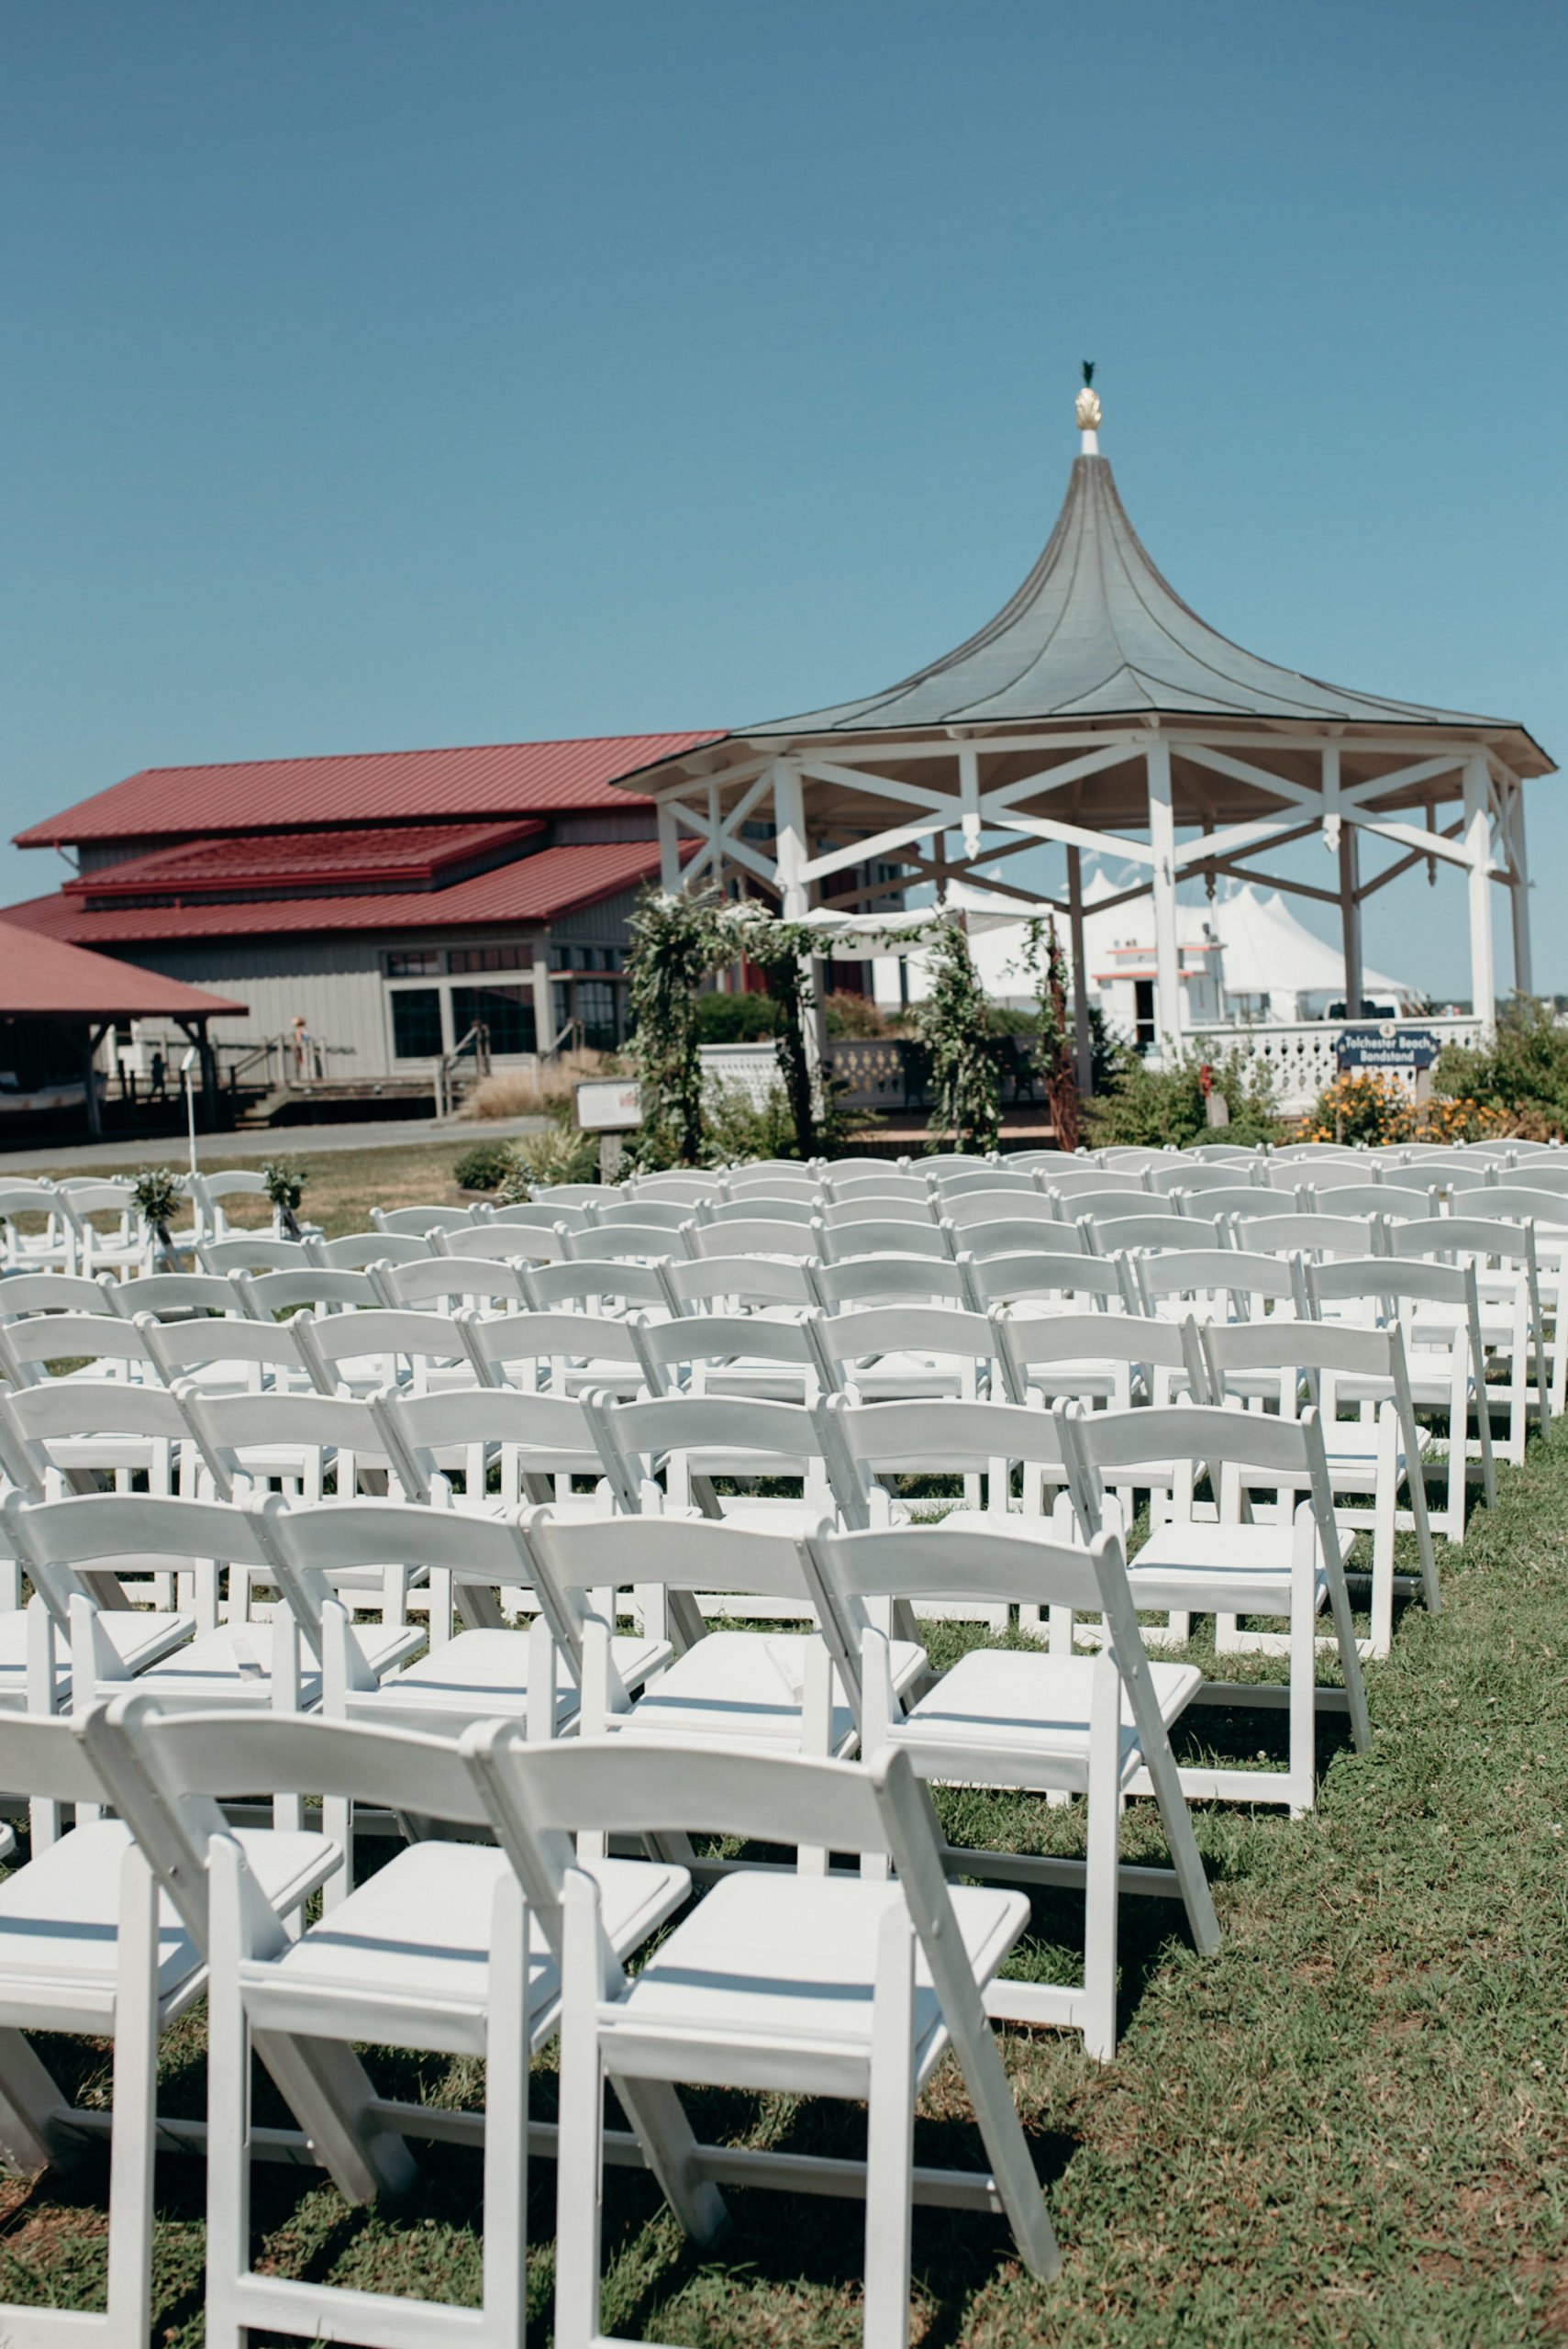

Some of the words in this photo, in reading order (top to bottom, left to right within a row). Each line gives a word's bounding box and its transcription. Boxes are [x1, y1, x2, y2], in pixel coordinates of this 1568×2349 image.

[1345, 1036, 1396, 1049] Tolchester
[1399, 1037, 1430, 1049] Beach
[1360, 1050, 1414, 1063] Bandstand
